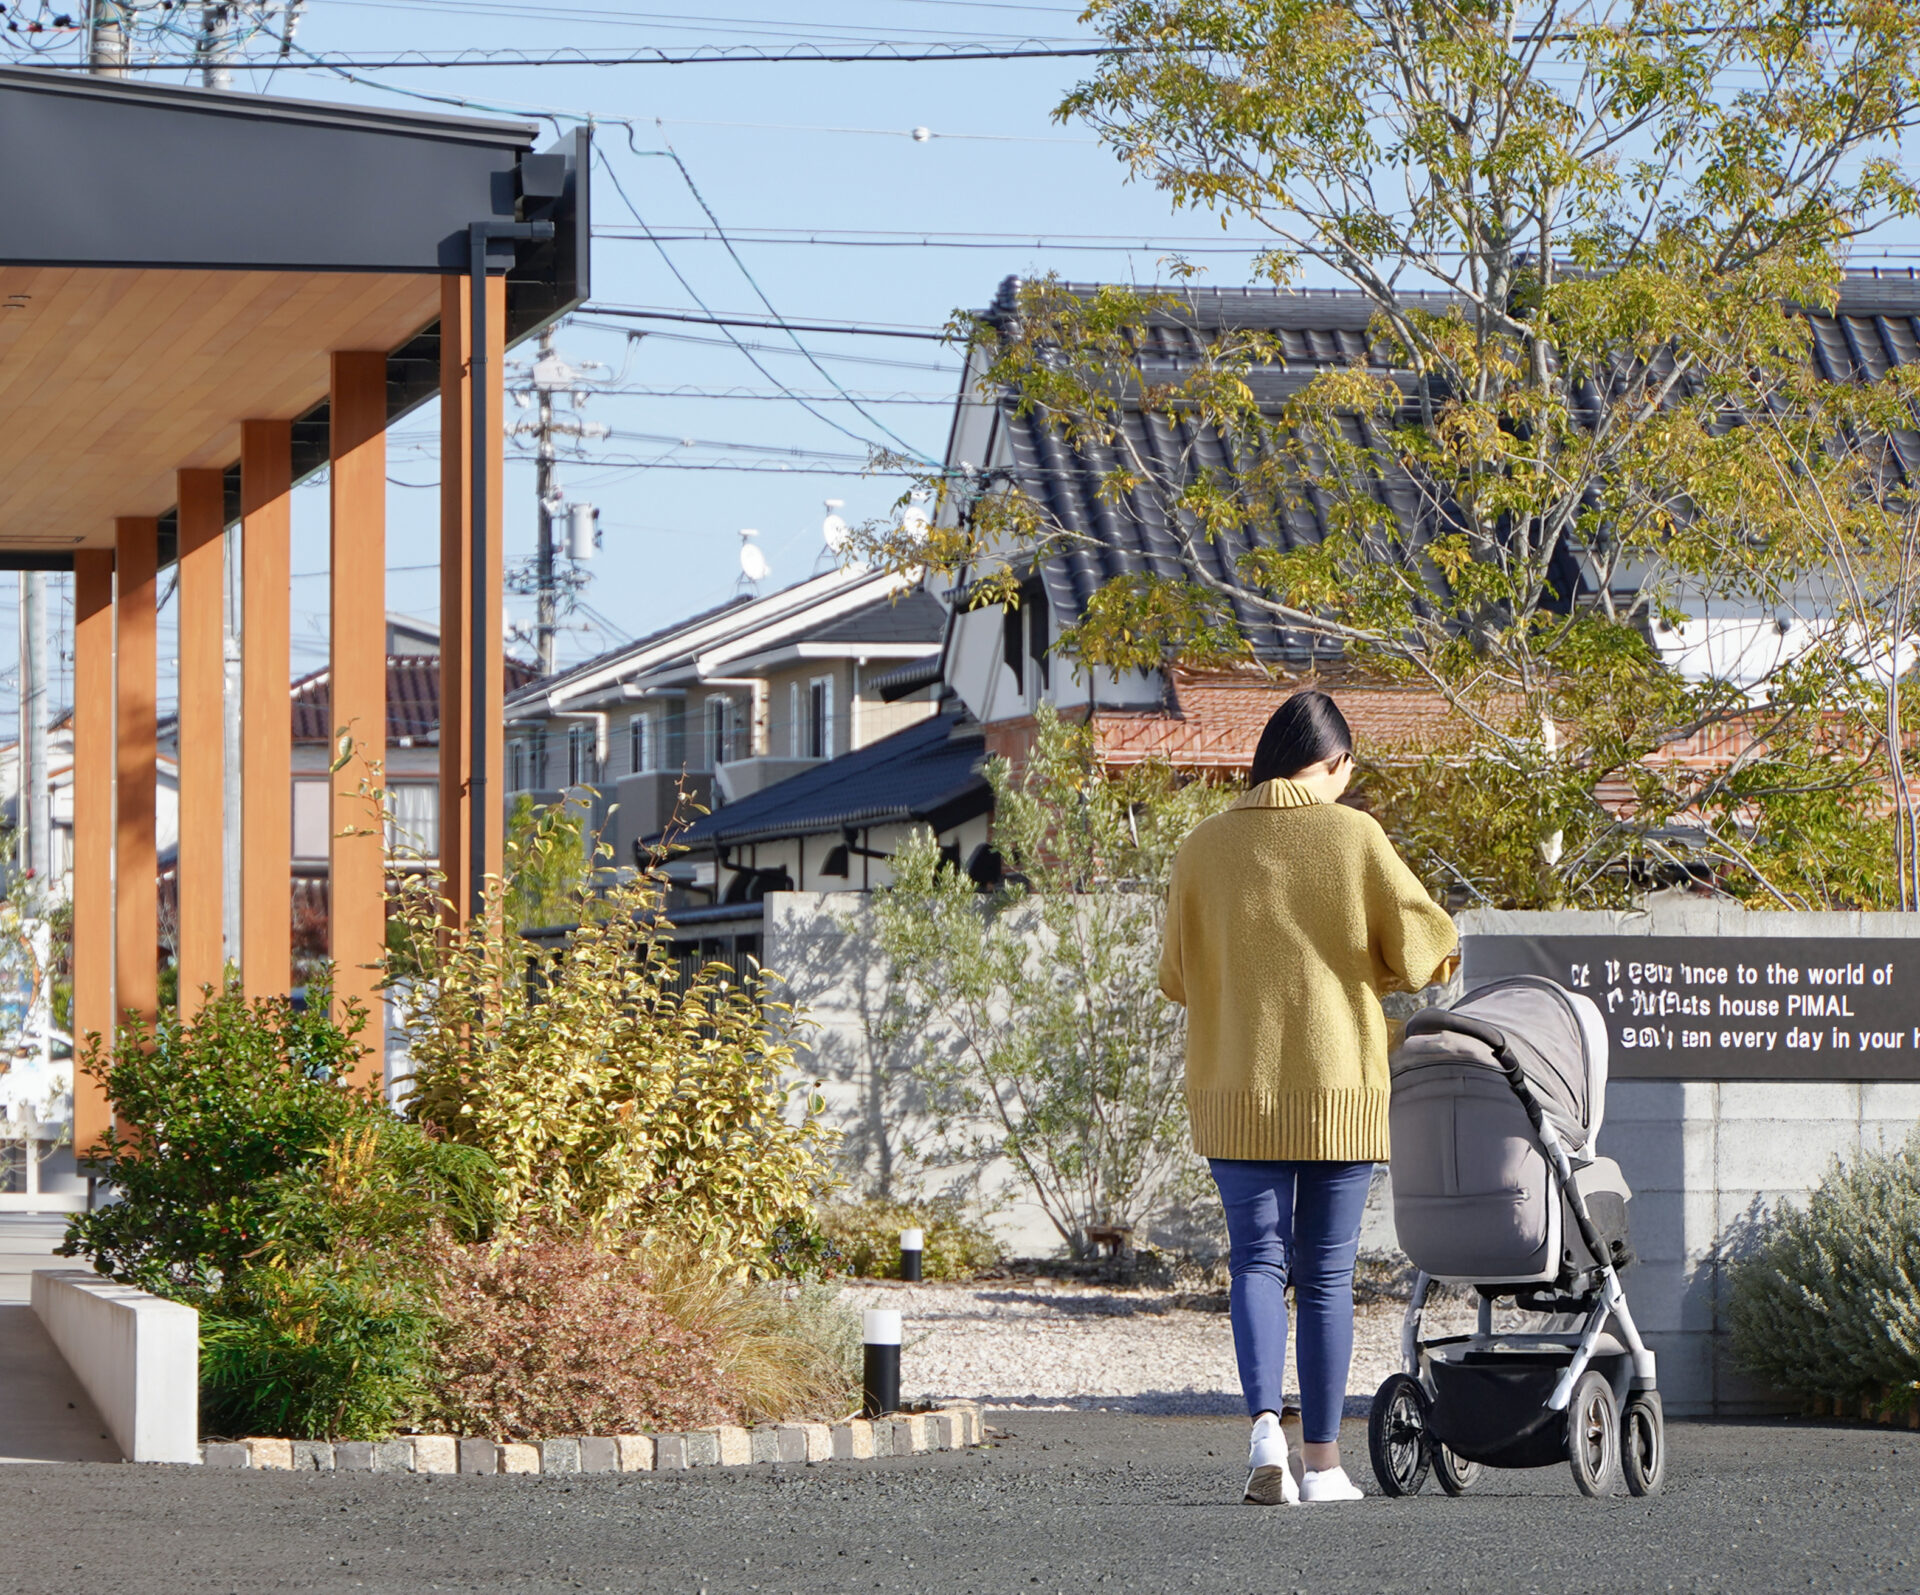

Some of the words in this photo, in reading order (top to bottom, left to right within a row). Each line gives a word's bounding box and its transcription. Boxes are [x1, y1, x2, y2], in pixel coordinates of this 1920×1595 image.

[1736, 963, 1758, 985] to
[1766, 962, 1799, 985] the
[1807, 962, 1864, 986] world
[1872, 963, 1894, 986] of
[1719, 993, 1780, 1017] house
[1787, 994, 1855, 1017] PIMAL
[1719, 1031, 1778, 1051] every
[1785, 1026, 1824, 1052] day
[1832, 1026, 1850, 1049] in
[1858, 1031, 1906, 1052] your
